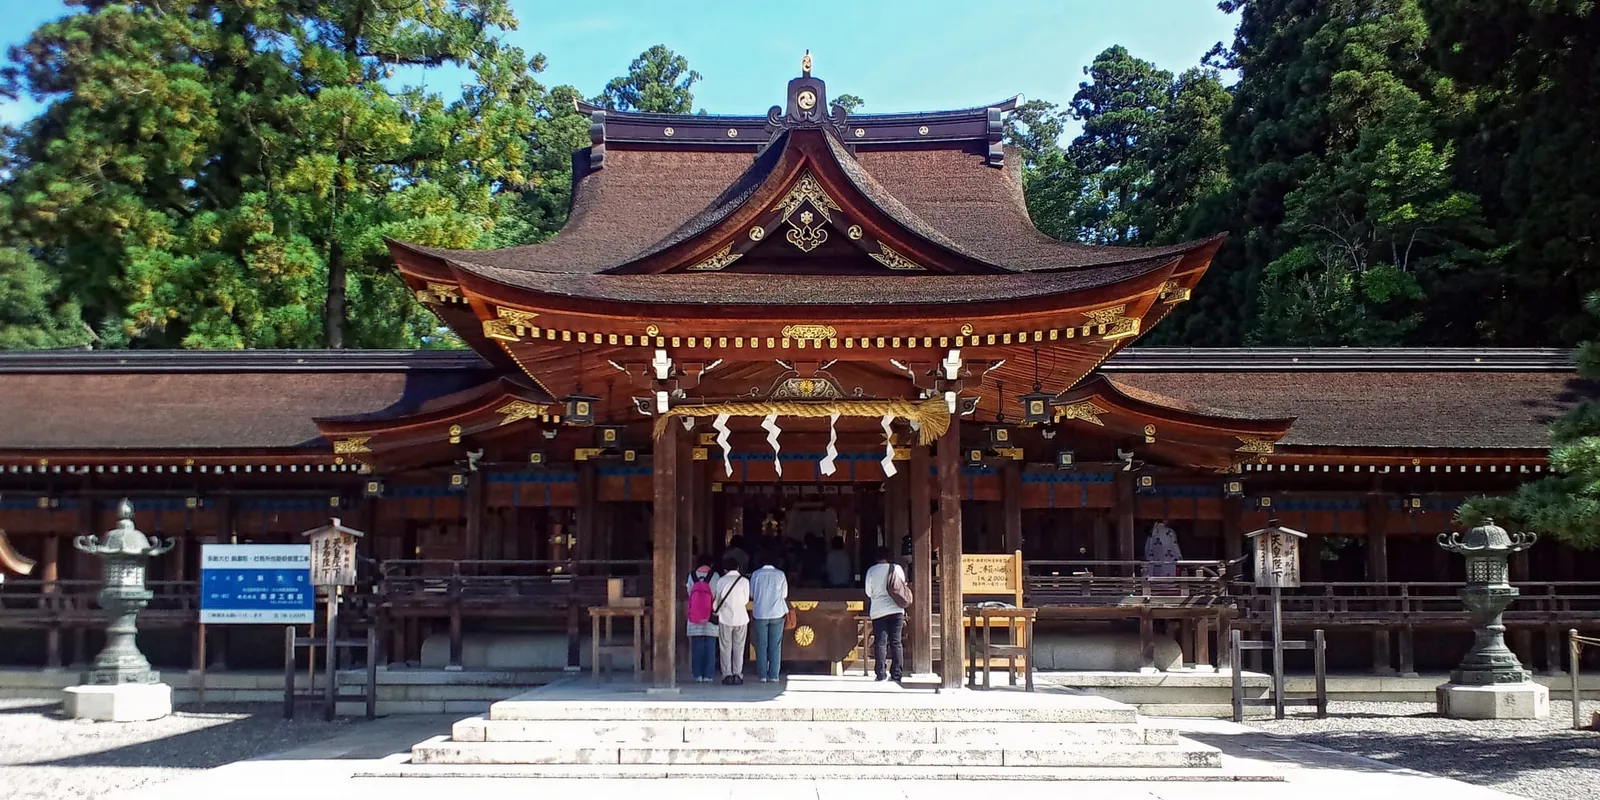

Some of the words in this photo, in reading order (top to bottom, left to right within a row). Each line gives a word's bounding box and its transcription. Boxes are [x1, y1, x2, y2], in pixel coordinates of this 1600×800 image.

[332, 537, 342, 578] 天皇陛下
[1271, 533, 1283, 583] 天皇陛下
